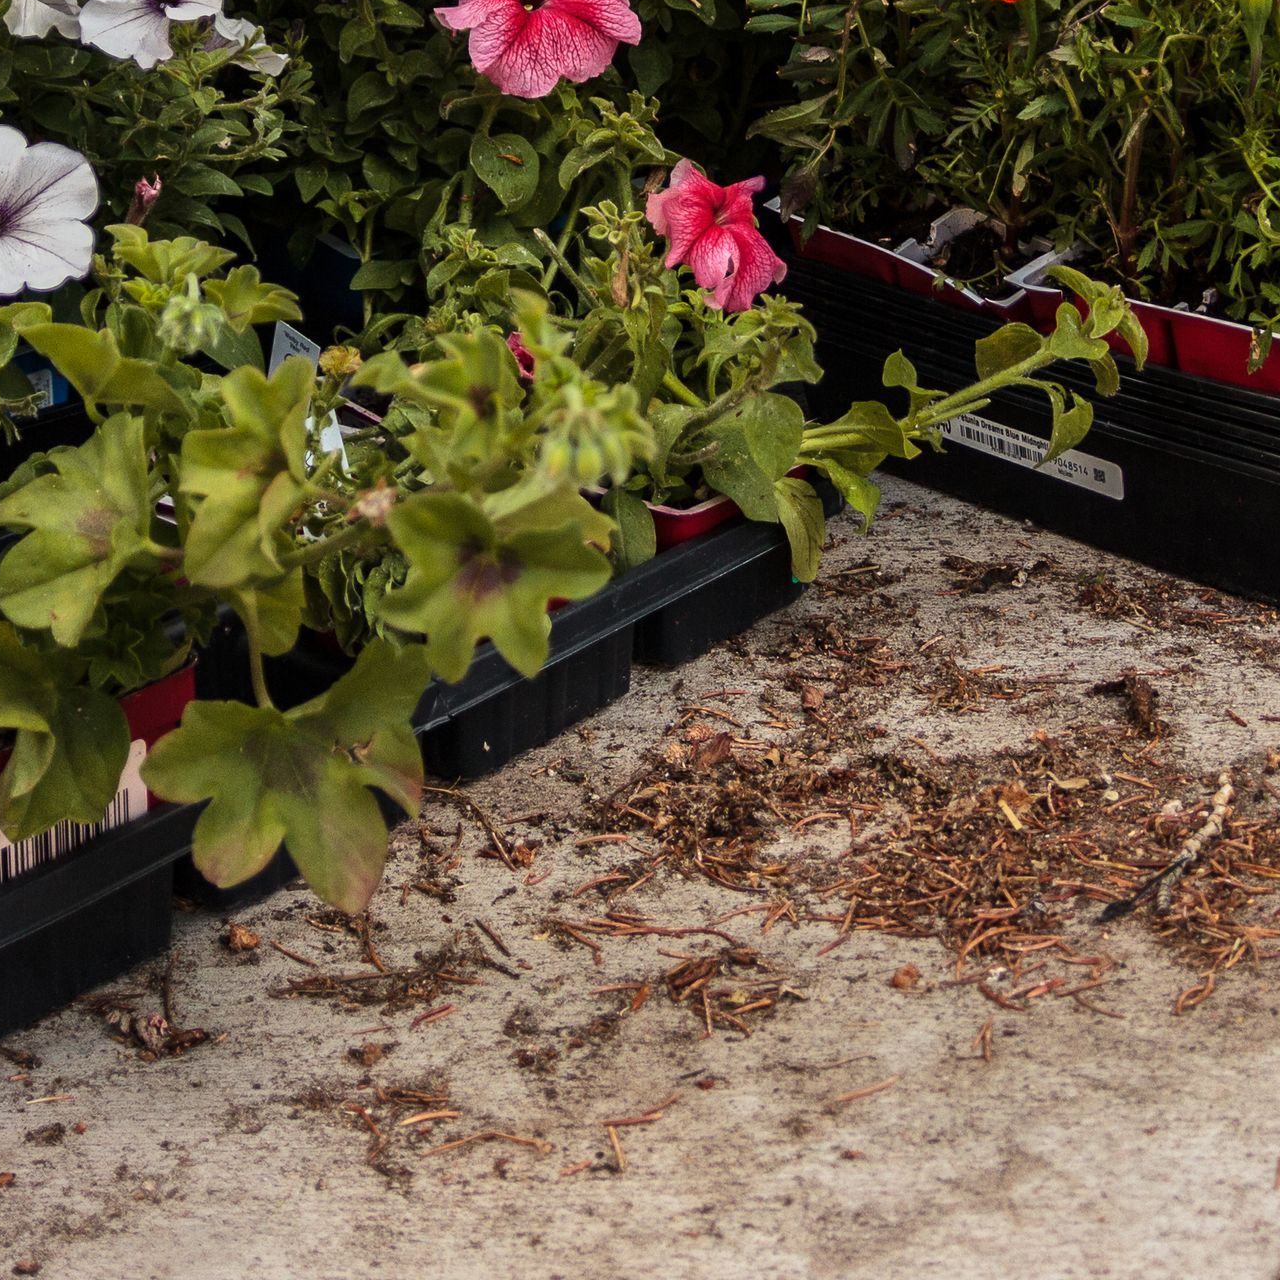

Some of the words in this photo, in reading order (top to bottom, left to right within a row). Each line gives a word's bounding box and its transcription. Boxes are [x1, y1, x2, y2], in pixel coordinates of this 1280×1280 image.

[957, 413, 980, 427] etunia
[981, 417, 1004, 436] Dreams
[1005, 427, 1020, 441] Blue
[1049, 457, 1089, 476] 9048514
